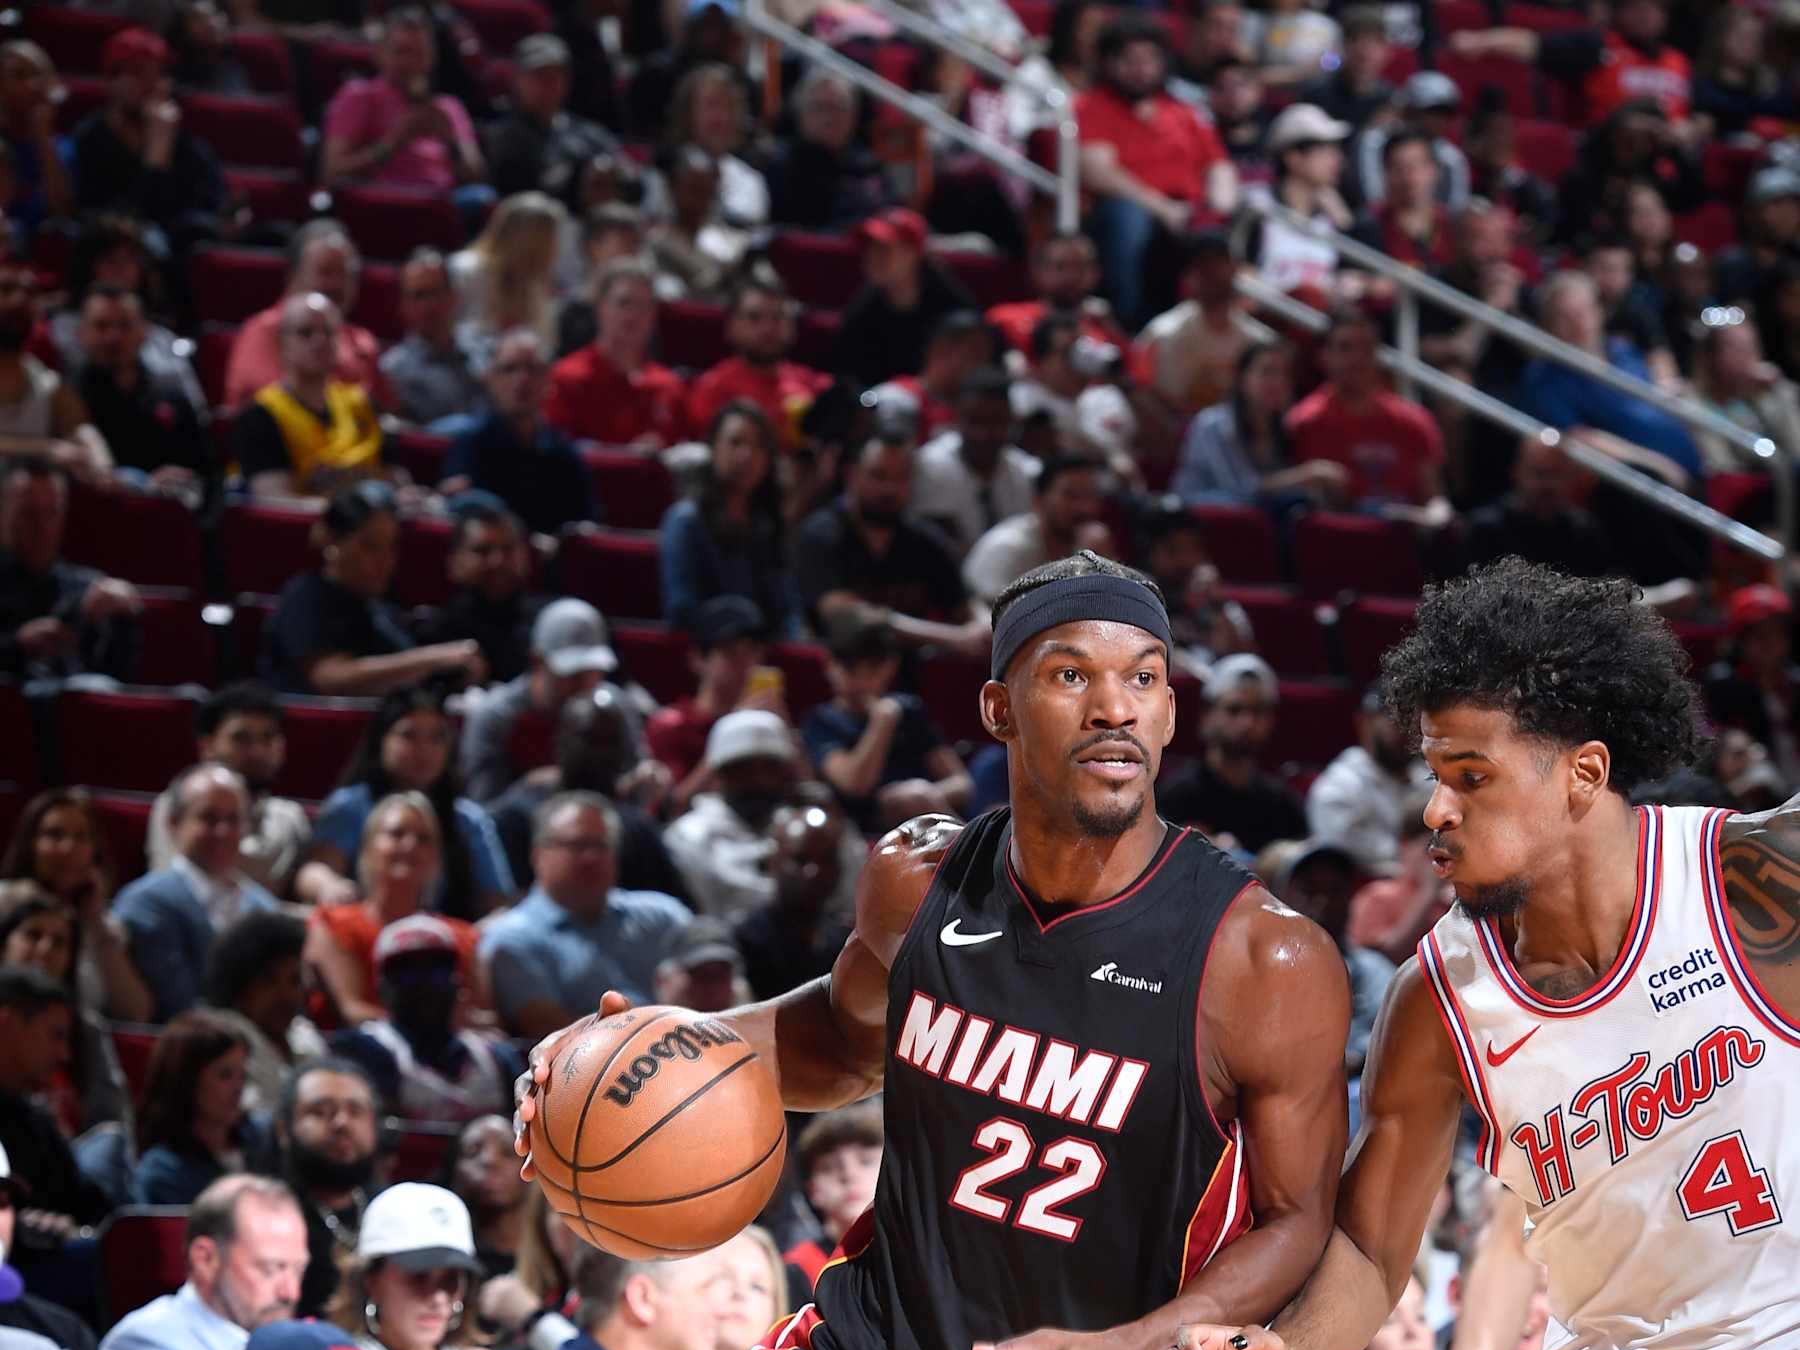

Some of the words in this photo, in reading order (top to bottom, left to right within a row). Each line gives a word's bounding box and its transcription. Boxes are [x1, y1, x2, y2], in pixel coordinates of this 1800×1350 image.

[1107, 971, 1163, 994] Carnival
[1648, 948, 1717, 989] credit
[1650, 972, 1727, 1013] karma
[895, 990, 1151, 1133] MIAMI
[1511, 1026, 1766, 1208] H-Town
[948, 1116, 1107, 1243] 22
[1676, 1129, 1782, 1236] 4
